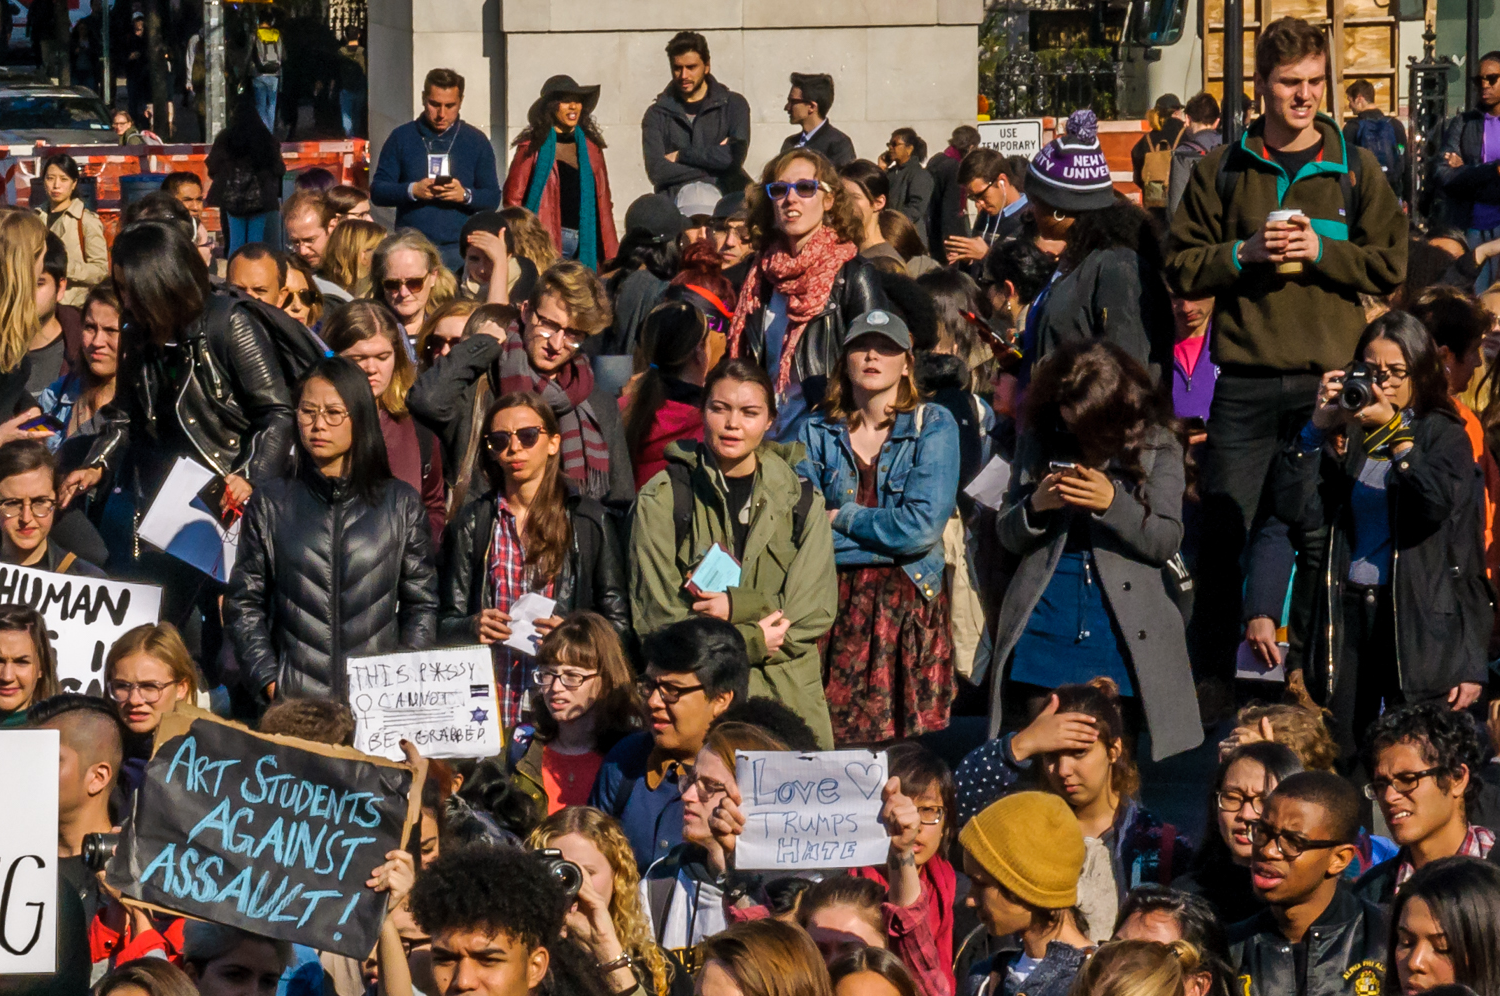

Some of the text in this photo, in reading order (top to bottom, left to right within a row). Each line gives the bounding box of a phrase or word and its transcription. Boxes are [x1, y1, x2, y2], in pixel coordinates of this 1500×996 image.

[1000, 128, 1018, 138] USE
[982, 140, 1036, 151] TEMPORARY
[1062, 164, 1110, 179] UNIVE
[1073, 154, 1100, 167] NEW
[352, 664, 410, 691] THIS
[377, 691, 463, 709] CANNOT
[368, 731, 399, 751] BE
[165, 735, 385, 829] ART STUDENTS
[753, 757, 841, 807] Love
[748, 810, 859, 839] TRUMPS
[187, 795, 377, 881] AGAINST
[776, 836, 858, 864] HATE
